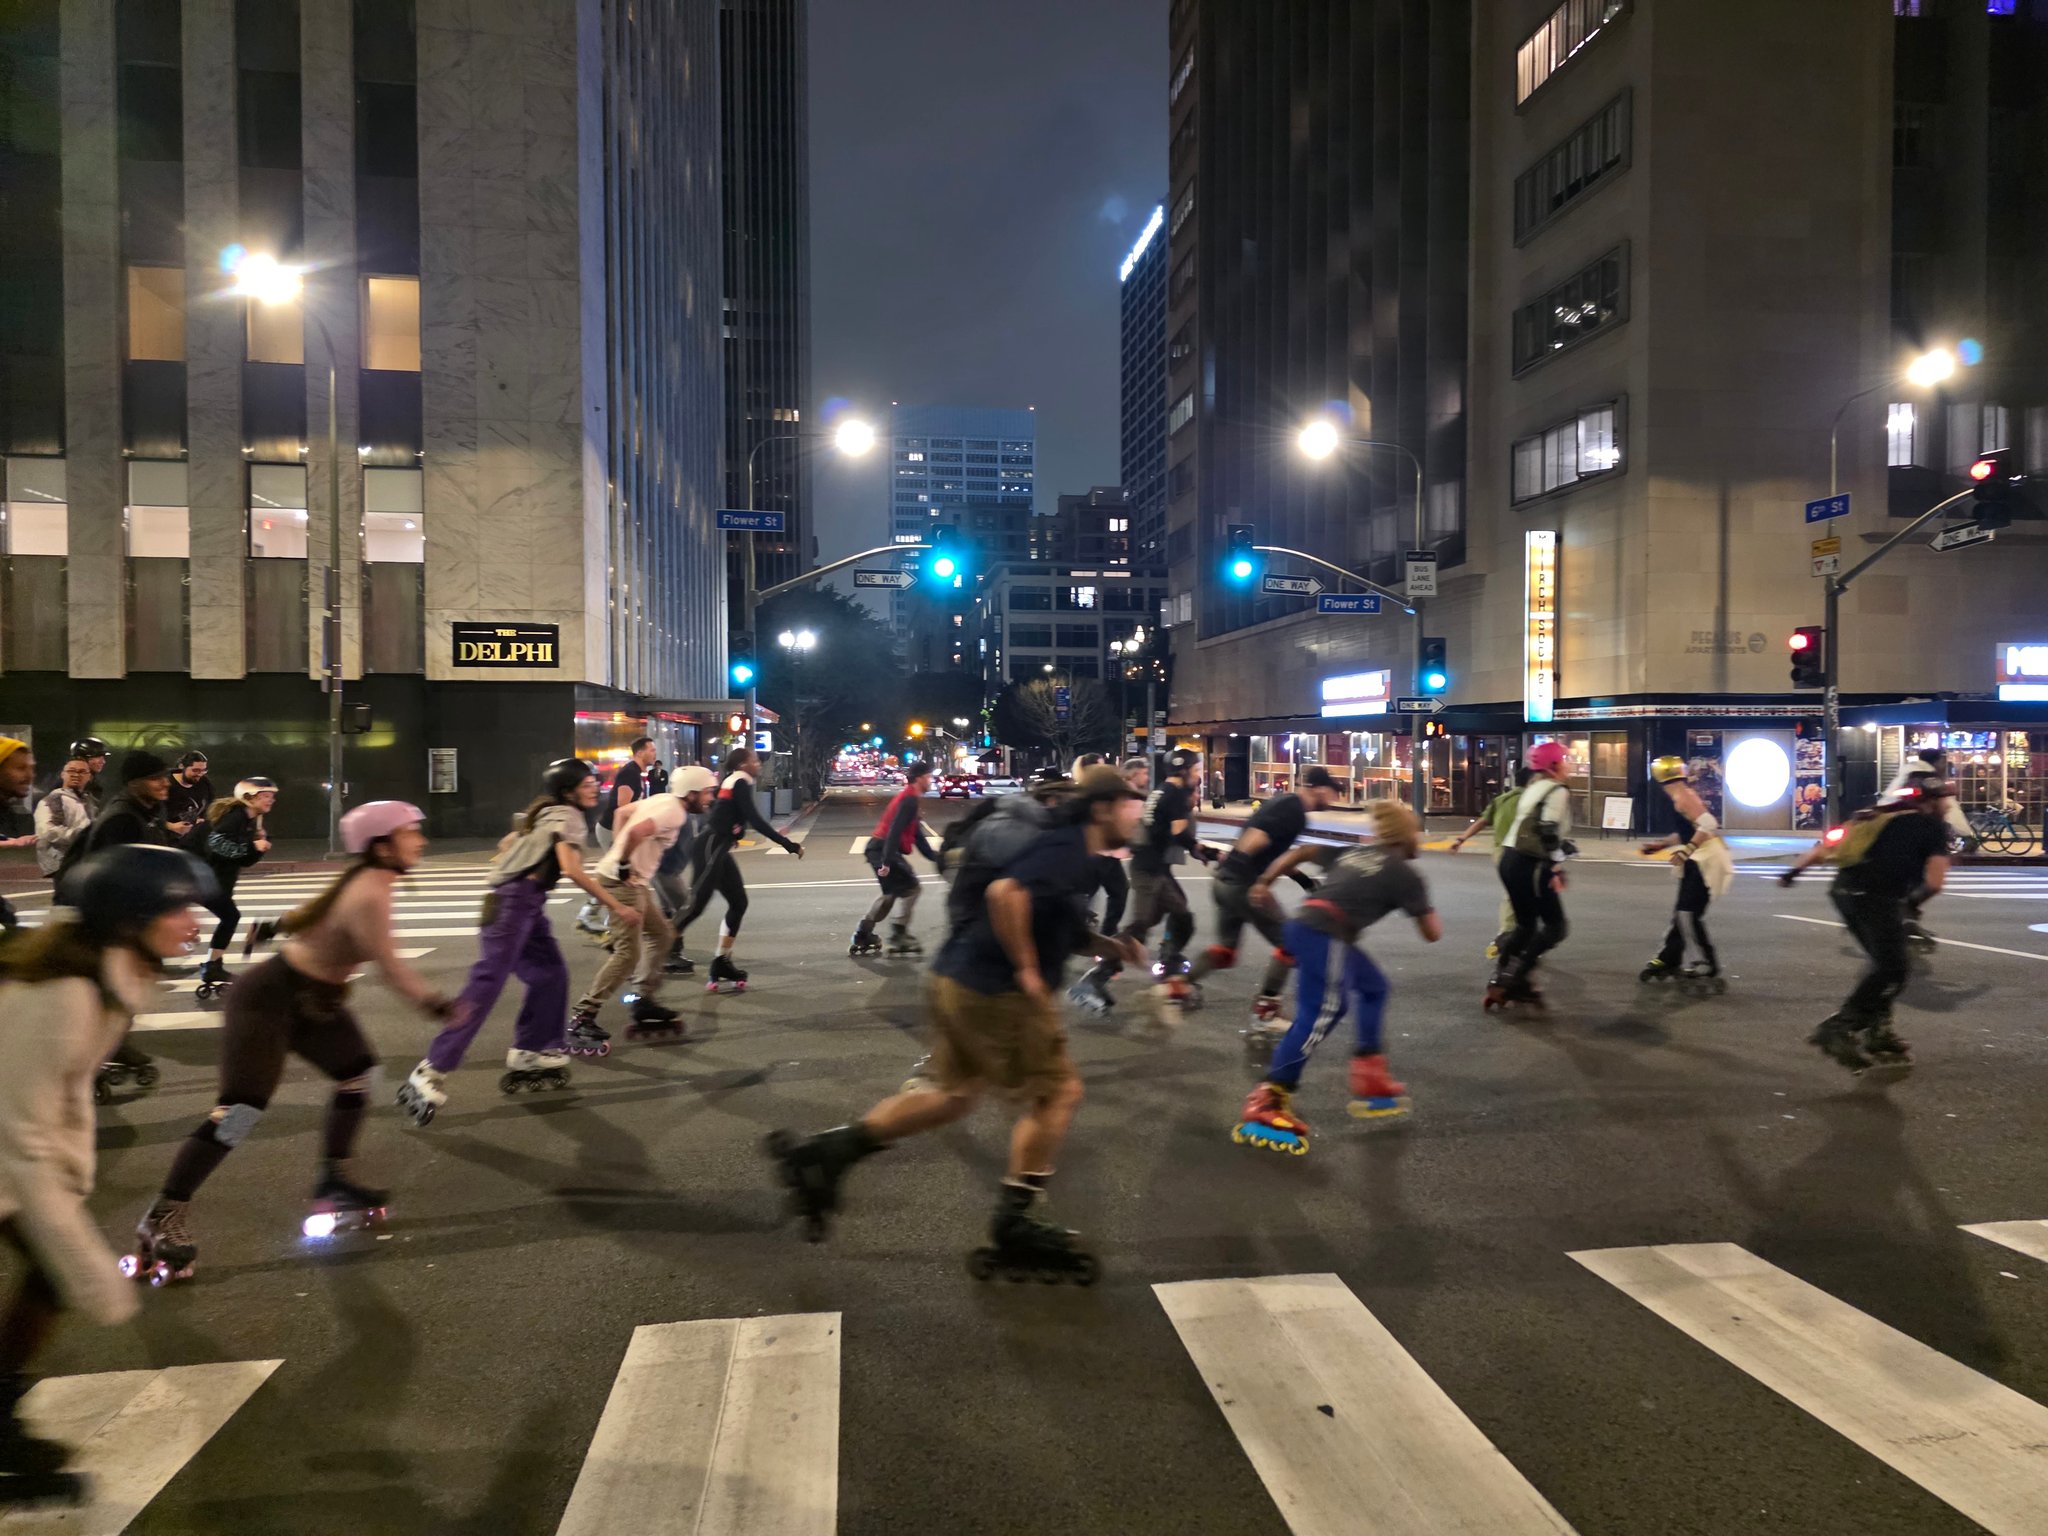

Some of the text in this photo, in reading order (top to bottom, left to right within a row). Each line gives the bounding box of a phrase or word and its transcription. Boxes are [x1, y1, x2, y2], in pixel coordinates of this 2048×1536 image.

[1830, 500, 1844, 513] St
[722, 514, 777, 527] Flower St
[1943, 531, 1961, 546] ONE
[1413, 565, 1428, 573] BUS
[857, 574, 901, 584] ONE WAY
[1266, 579, 1310, 590] ONE WAY
[1324, 598, 1375, 609] Flower St
[495, 628, 517, 637] THE
[459, 642, 553, 662] DELPHI
